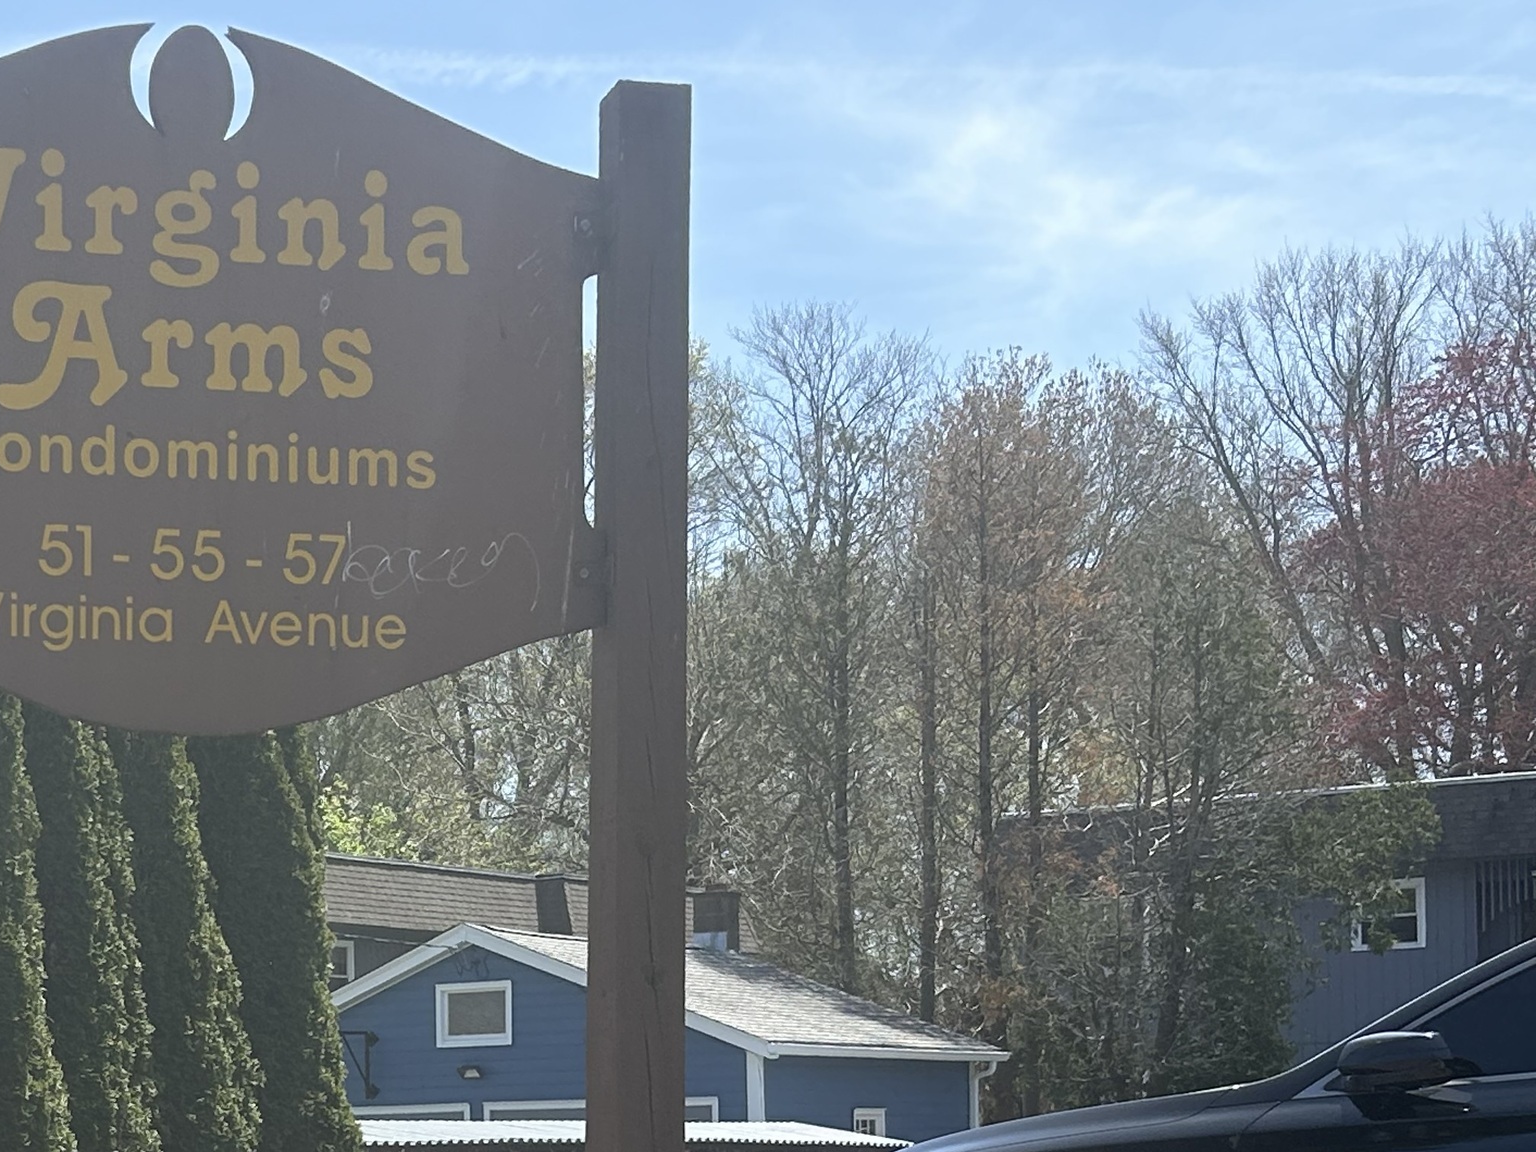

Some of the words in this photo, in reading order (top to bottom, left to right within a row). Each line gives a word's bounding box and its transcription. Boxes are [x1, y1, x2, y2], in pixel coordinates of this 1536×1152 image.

[38, 523, 92, 577] 51
[150, 527, 226, 582] 55
[282, 532, 347, 586] 57
[205, 599, 407, 650] Avenue
